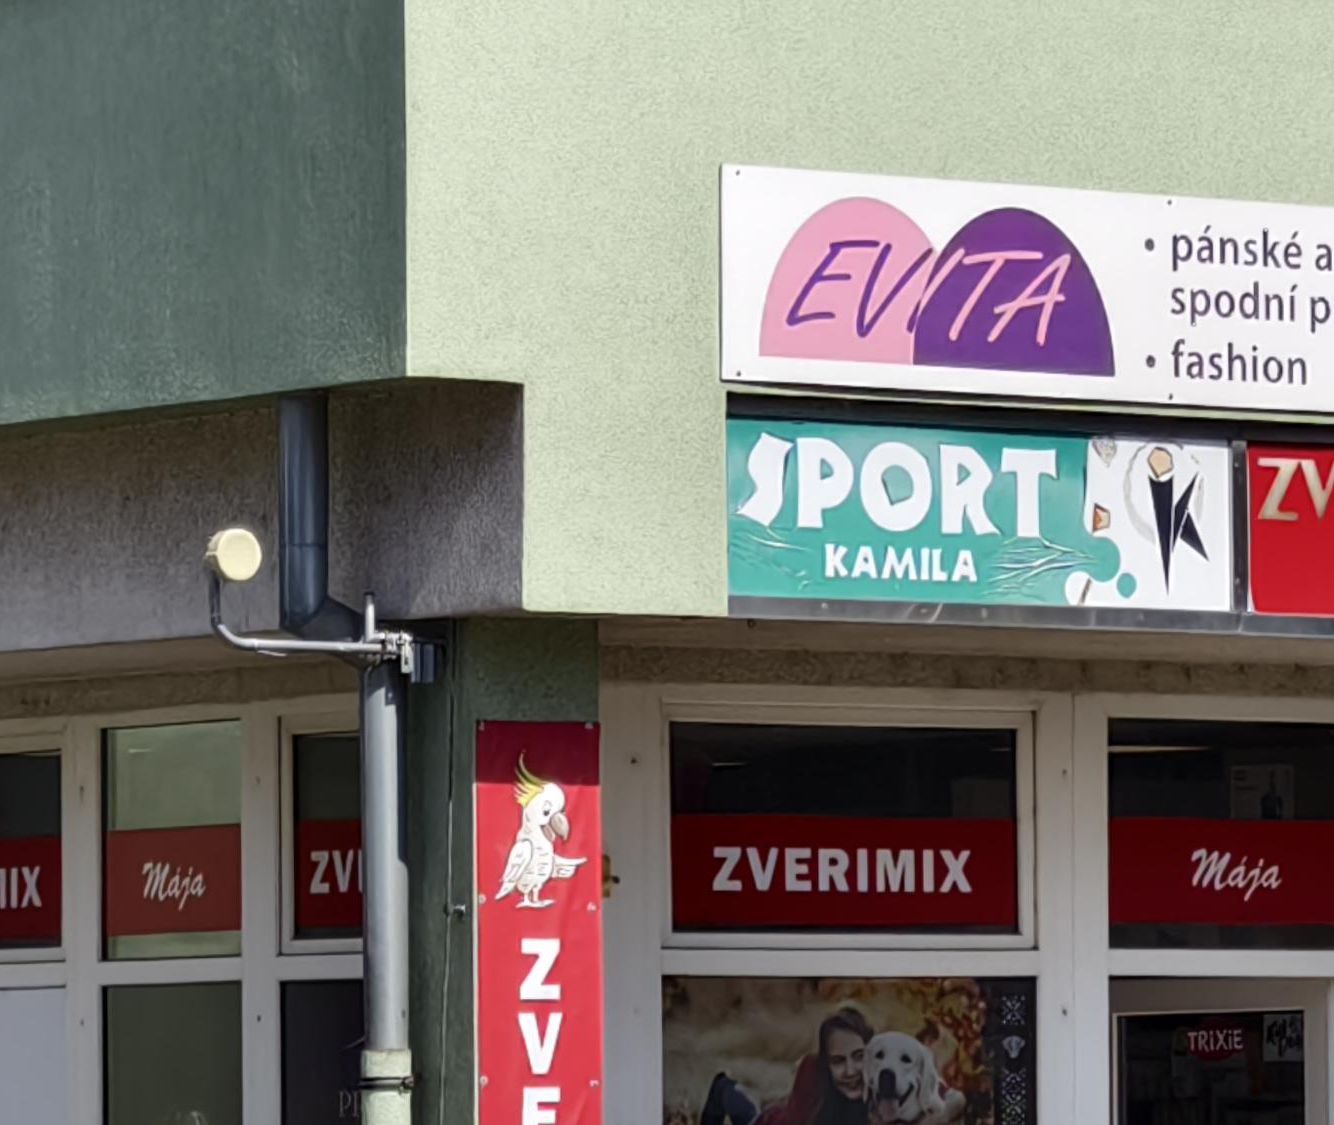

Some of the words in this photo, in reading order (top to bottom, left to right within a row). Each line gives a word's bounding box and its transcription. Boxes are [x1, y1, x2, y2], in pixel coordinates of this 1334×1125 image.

[1170, 226, 1304, 274] pánské
[1316, 243, 1334, 273] a
[787, 239, 1070, 348] EVITA
[1170, 280, 1297, 326] spodní
[1170, 339, 1308, 386] fashion
[736, 432, 1058, 540] SPORT
[825, 544, 978, 583] KAMILA
[142, 861, 206, 910] Mája
[712, 847, 973, 893] ZVERIMIX
[1190, 847, 1282, 902] Mája
